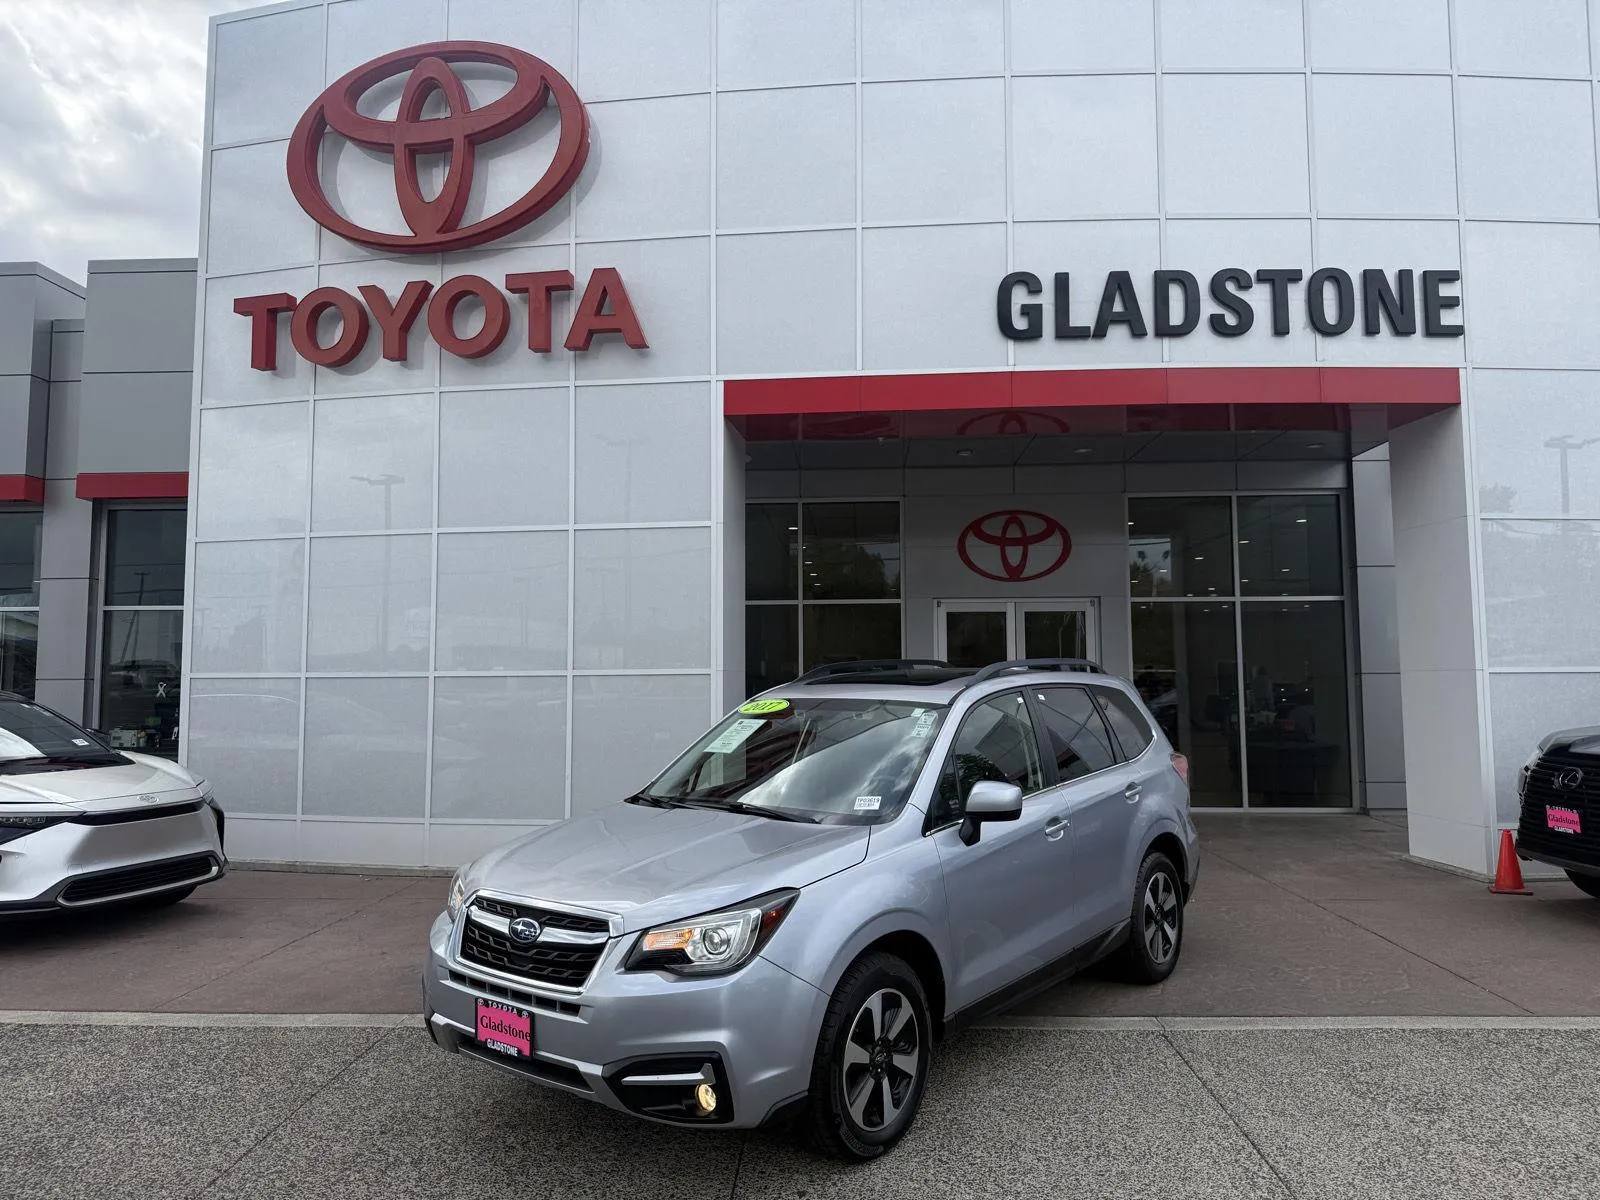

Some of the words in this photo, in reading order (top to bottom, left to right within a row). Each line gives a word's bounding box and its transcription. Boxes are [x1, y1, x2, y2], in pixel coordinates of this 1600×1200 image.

[997, 267, 1464, 340] GLADSTONE
[233, 267, 649, 371] TOYOTA
[743, 701, 783, 711] 2017
[488, 1001, 517, 1014] TOYOTA
[480, 1015, 531, 1041] Gladstone
[487, 1038, 518, 1057] GLADSTONE
